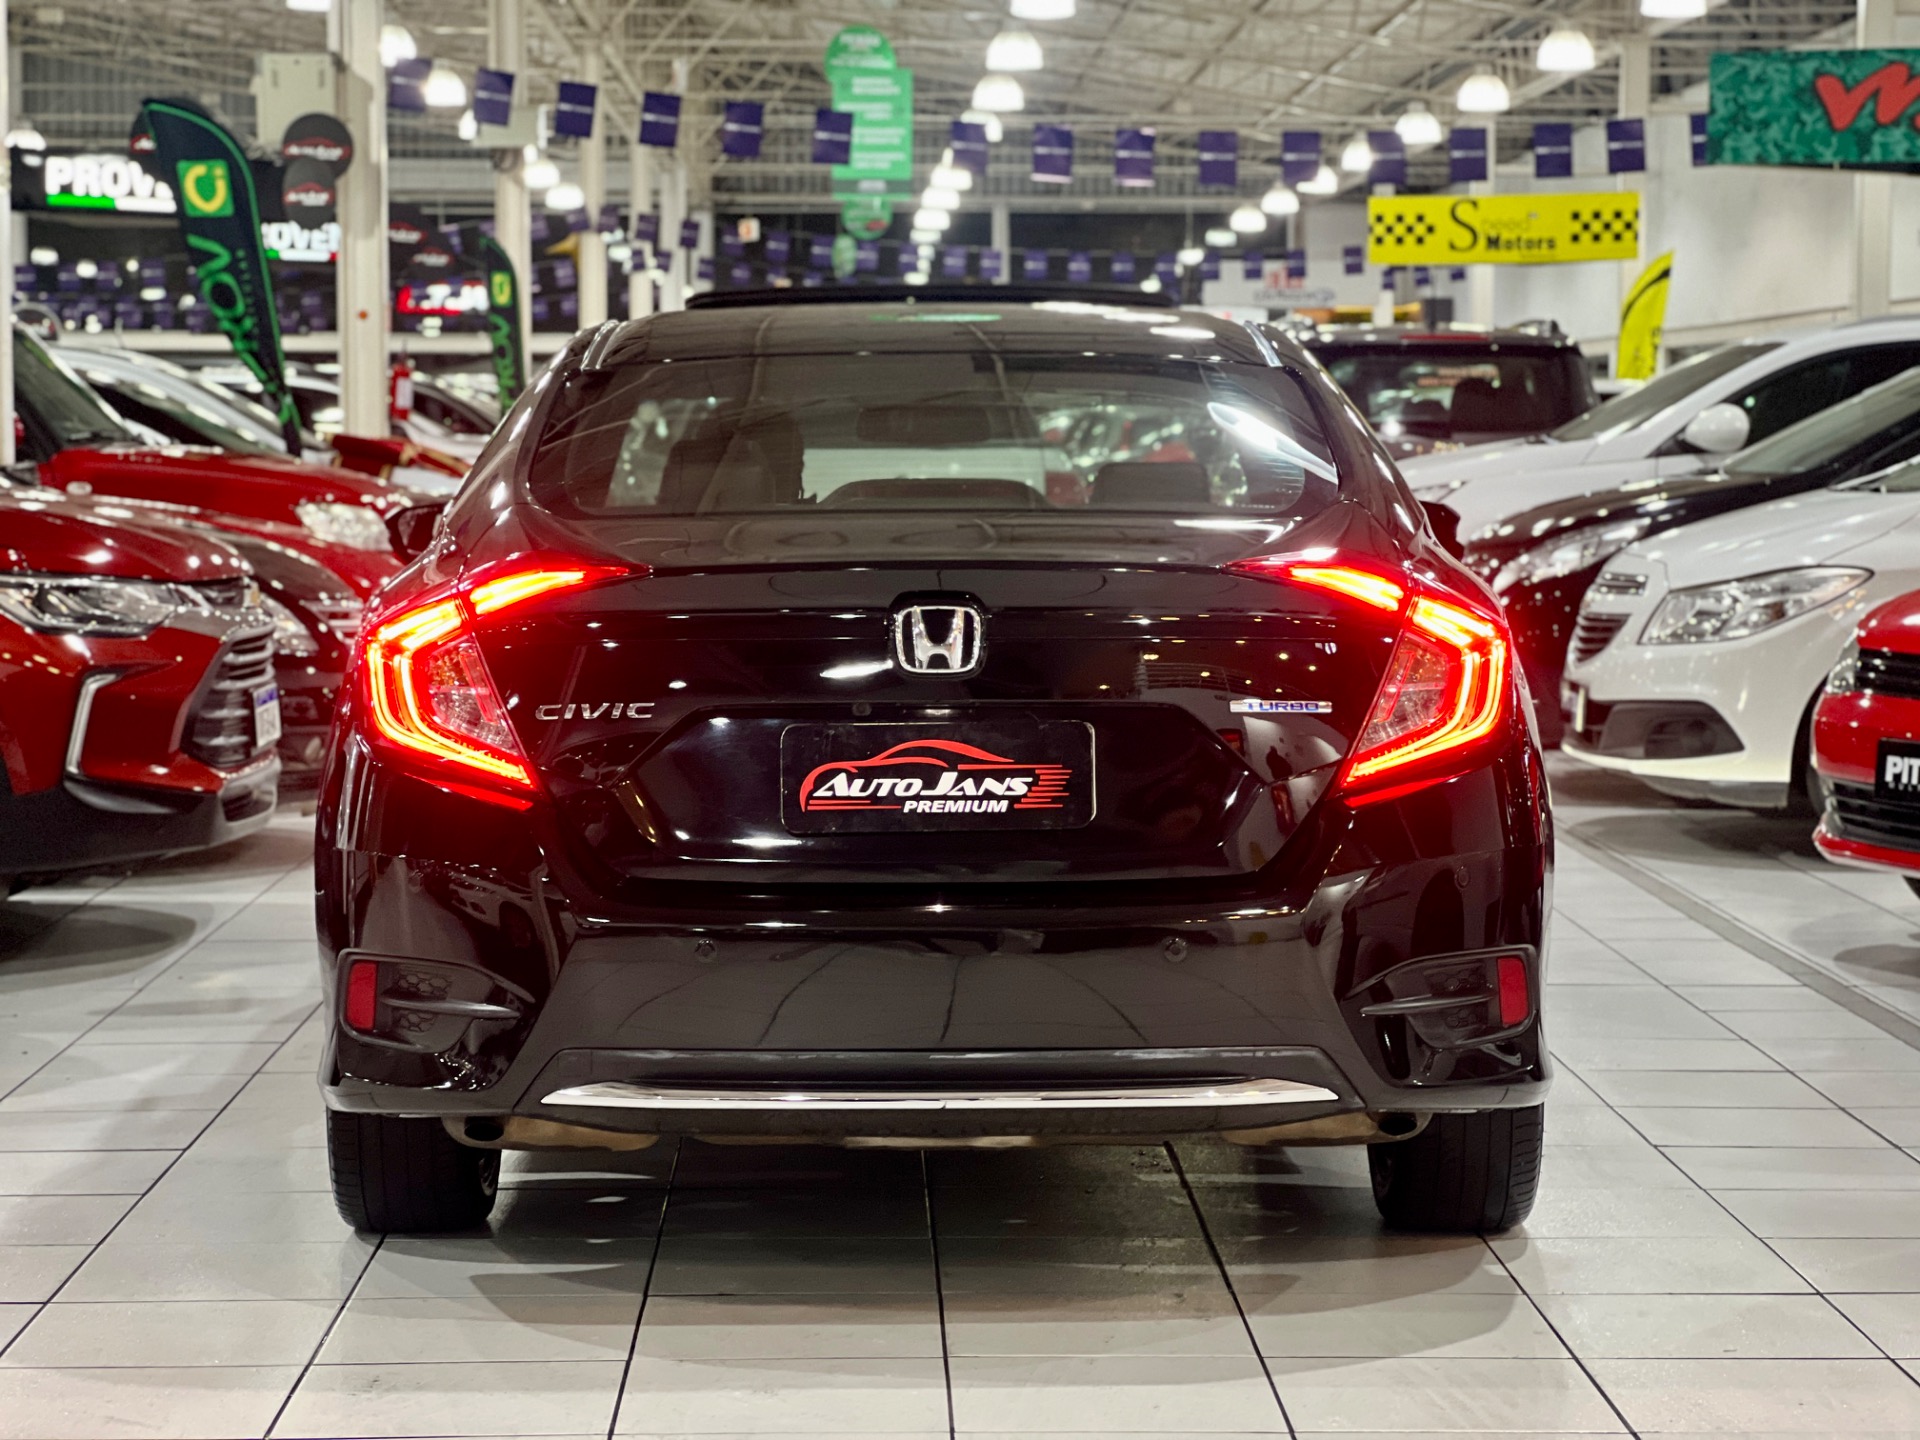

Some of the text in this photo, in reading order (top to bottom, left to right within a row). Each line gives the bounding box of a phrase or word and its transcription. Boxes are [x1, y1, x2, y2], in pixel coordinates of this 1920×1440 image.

[1486, 234, 1556, 251] Motors
[535, 702, 655, 720] CIVIC
[1246, 702, 1319, 711] TURBO
[903, 800, 1009, 813] PREMIUM
